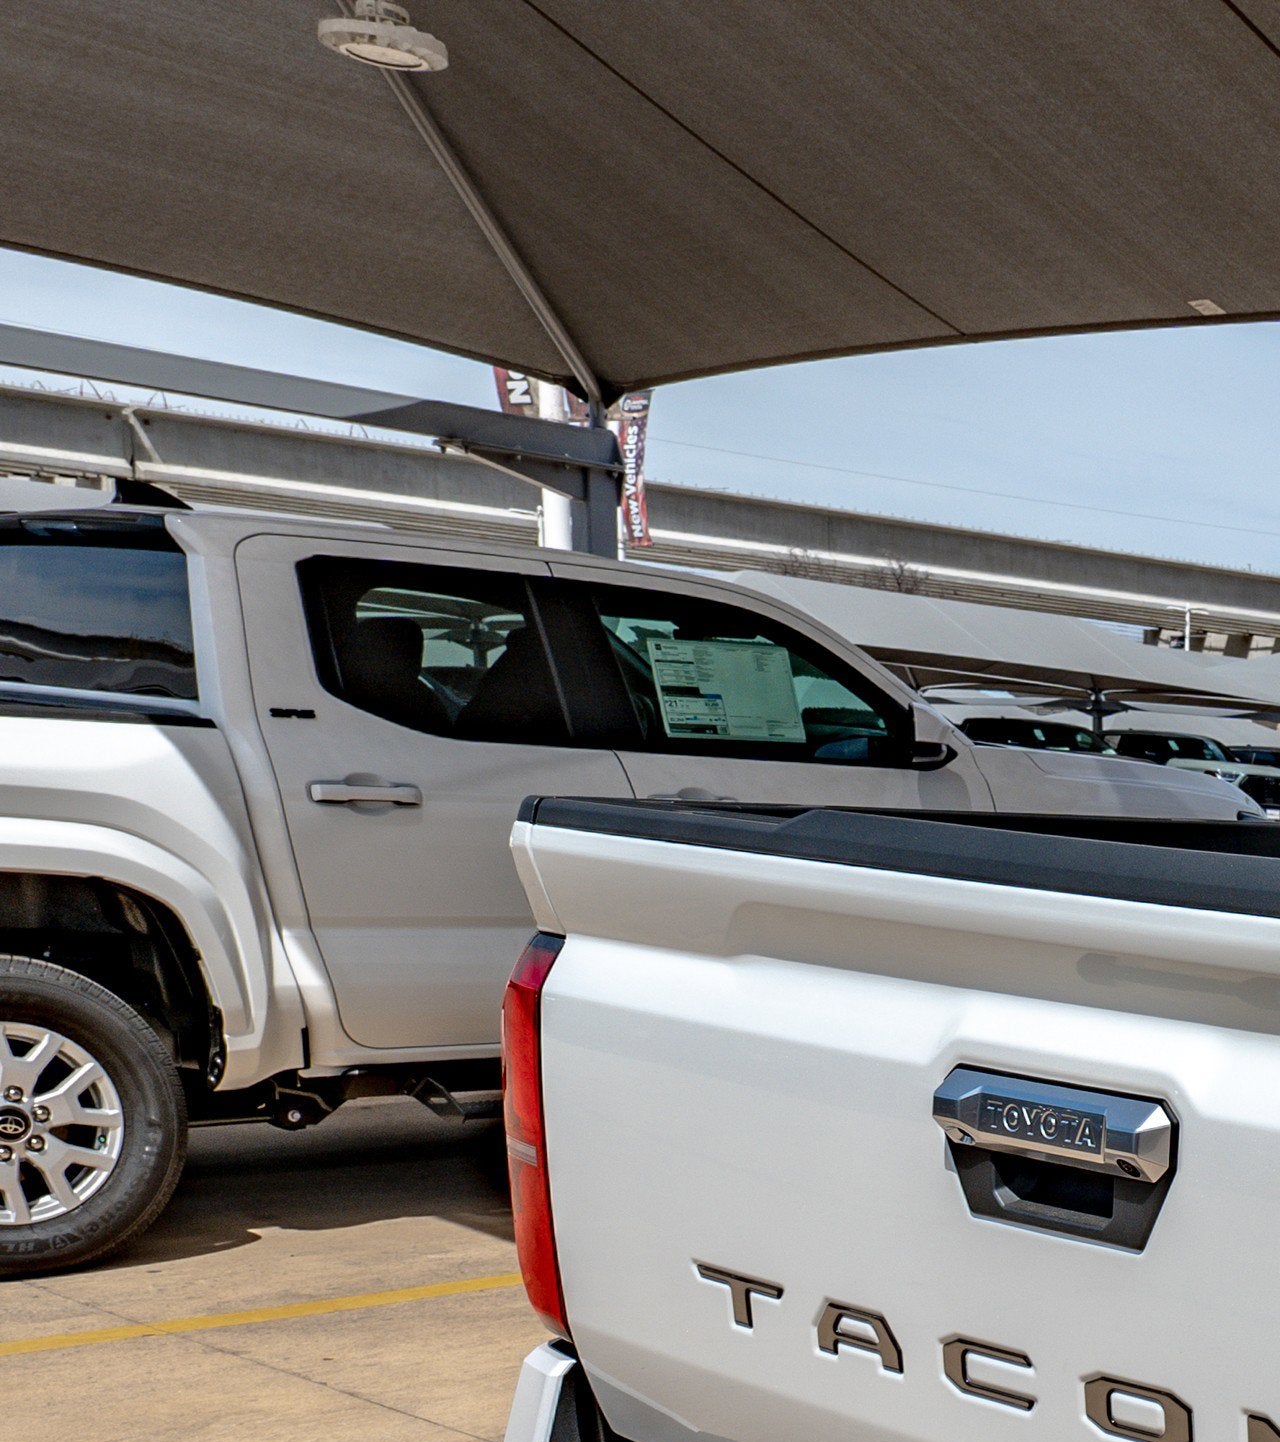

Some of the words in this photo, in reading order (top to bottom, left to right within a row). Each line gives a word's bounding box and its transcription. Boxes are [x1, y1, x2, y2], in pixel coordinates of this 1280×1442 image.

[623, 425, 639, 497] Vehicles
[628, 499, 644, 538] New
[987, 1100, 1096, 1148] TOYOTA
